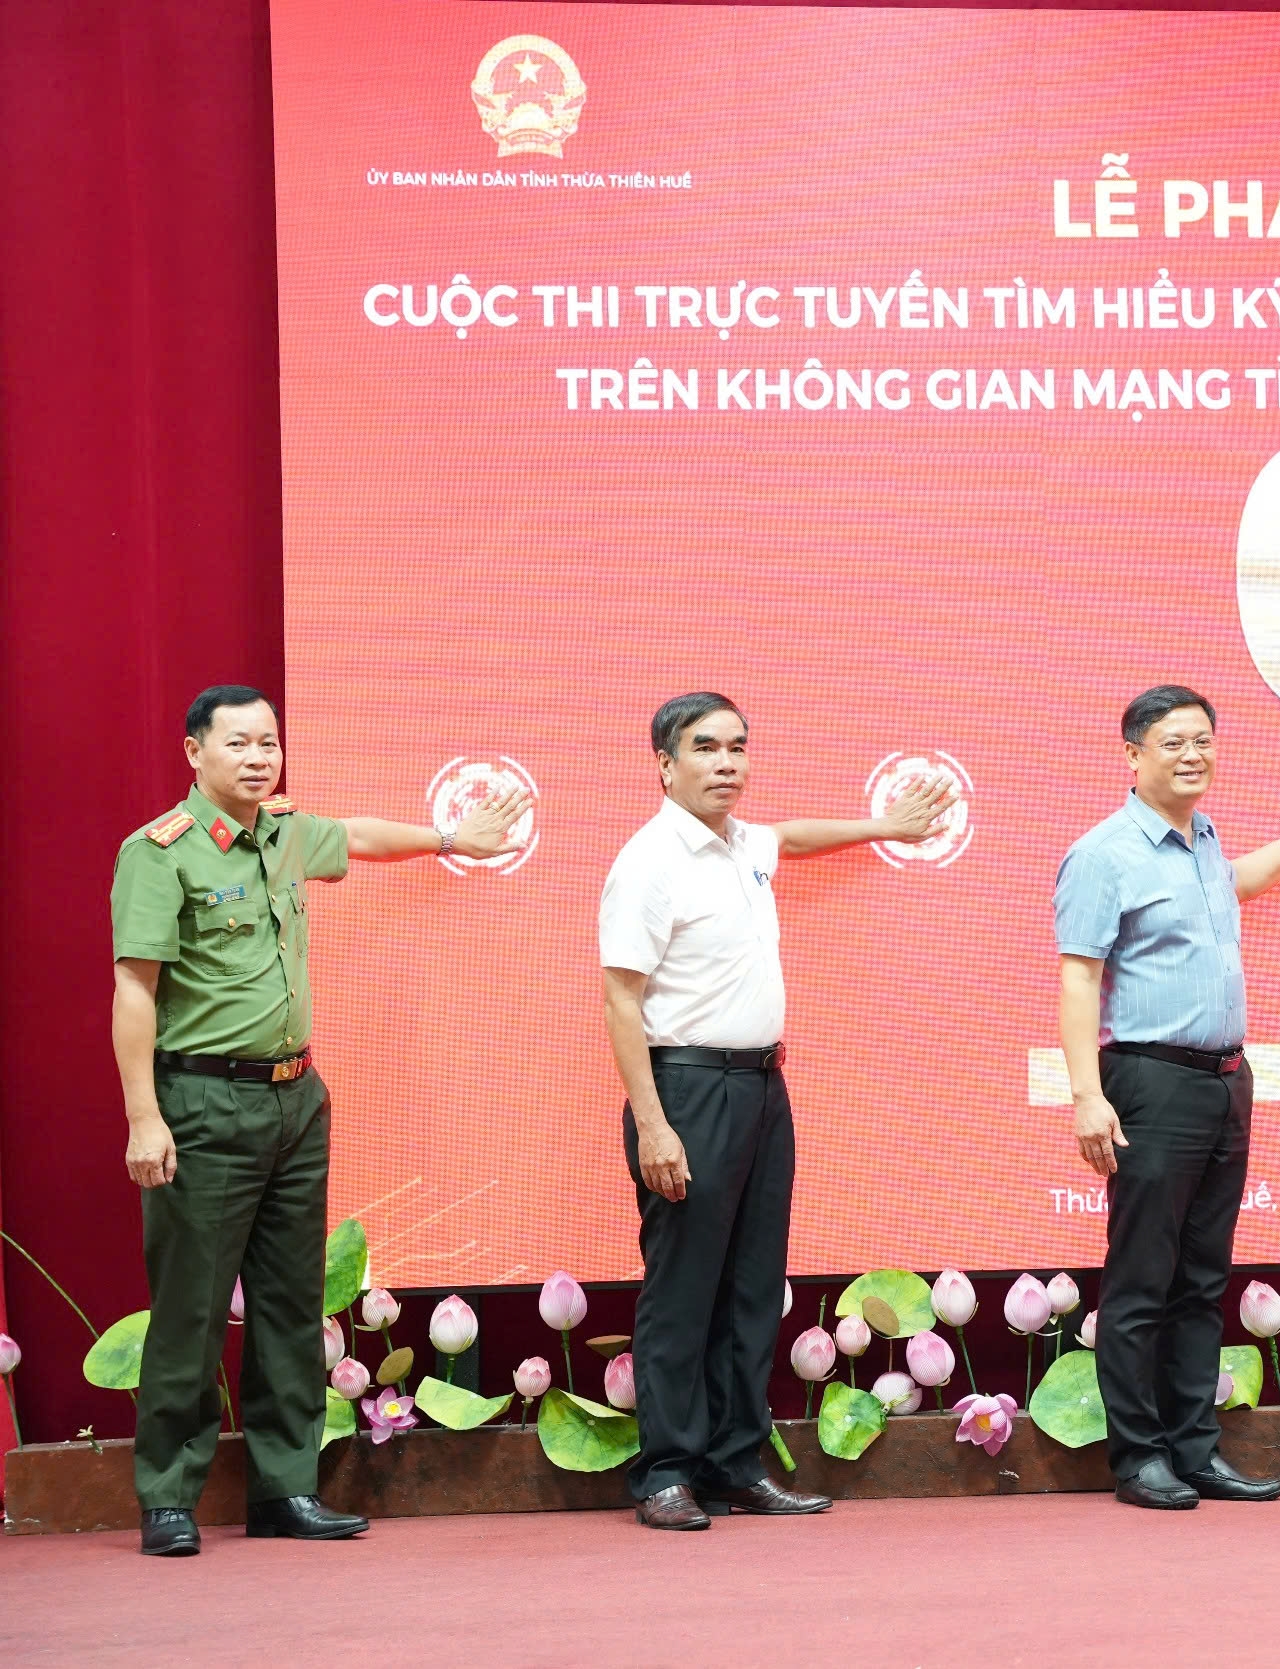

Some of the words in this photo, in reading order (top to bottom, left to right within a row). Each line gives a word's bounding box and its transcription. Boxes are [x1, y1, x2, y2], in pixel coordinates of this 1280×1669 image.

[366, 166, 389, 185] ỦY
[393, 171, 426, 186] BAN
[431, 168, 478, 187] NHÂN
[482, 169, 517, 187] DÂN
[520, 168, 558, 187] TỈNH
[562, 170, 605, 188] THỪA
[609, 171, 655, 188] THIÊN
[659, 169, 692, 189] HUẾ
[1053, 152, 1139, 238] LỄ
[363, 273, 519, 340] CUỘC
[531, 285, 620, 328] THI
[634, 279, 781, 341] TRỰC
[792, 268, 969, 329] TUYẾN
[982, 275, 1076, 329] TÌM
[1093, 267, 1216, 329] HIỂU
[555, 356, 699, 411] TRÊN
[717, 357, 911, 411] KHÔNG
[925, 368, 1056, 411] GIAN
[1072, 368, 1232, 423] MẠNG
[1049, 1187, 1108, 1214] Thừ
[1240, 1181, 1278, 1212] uế,
